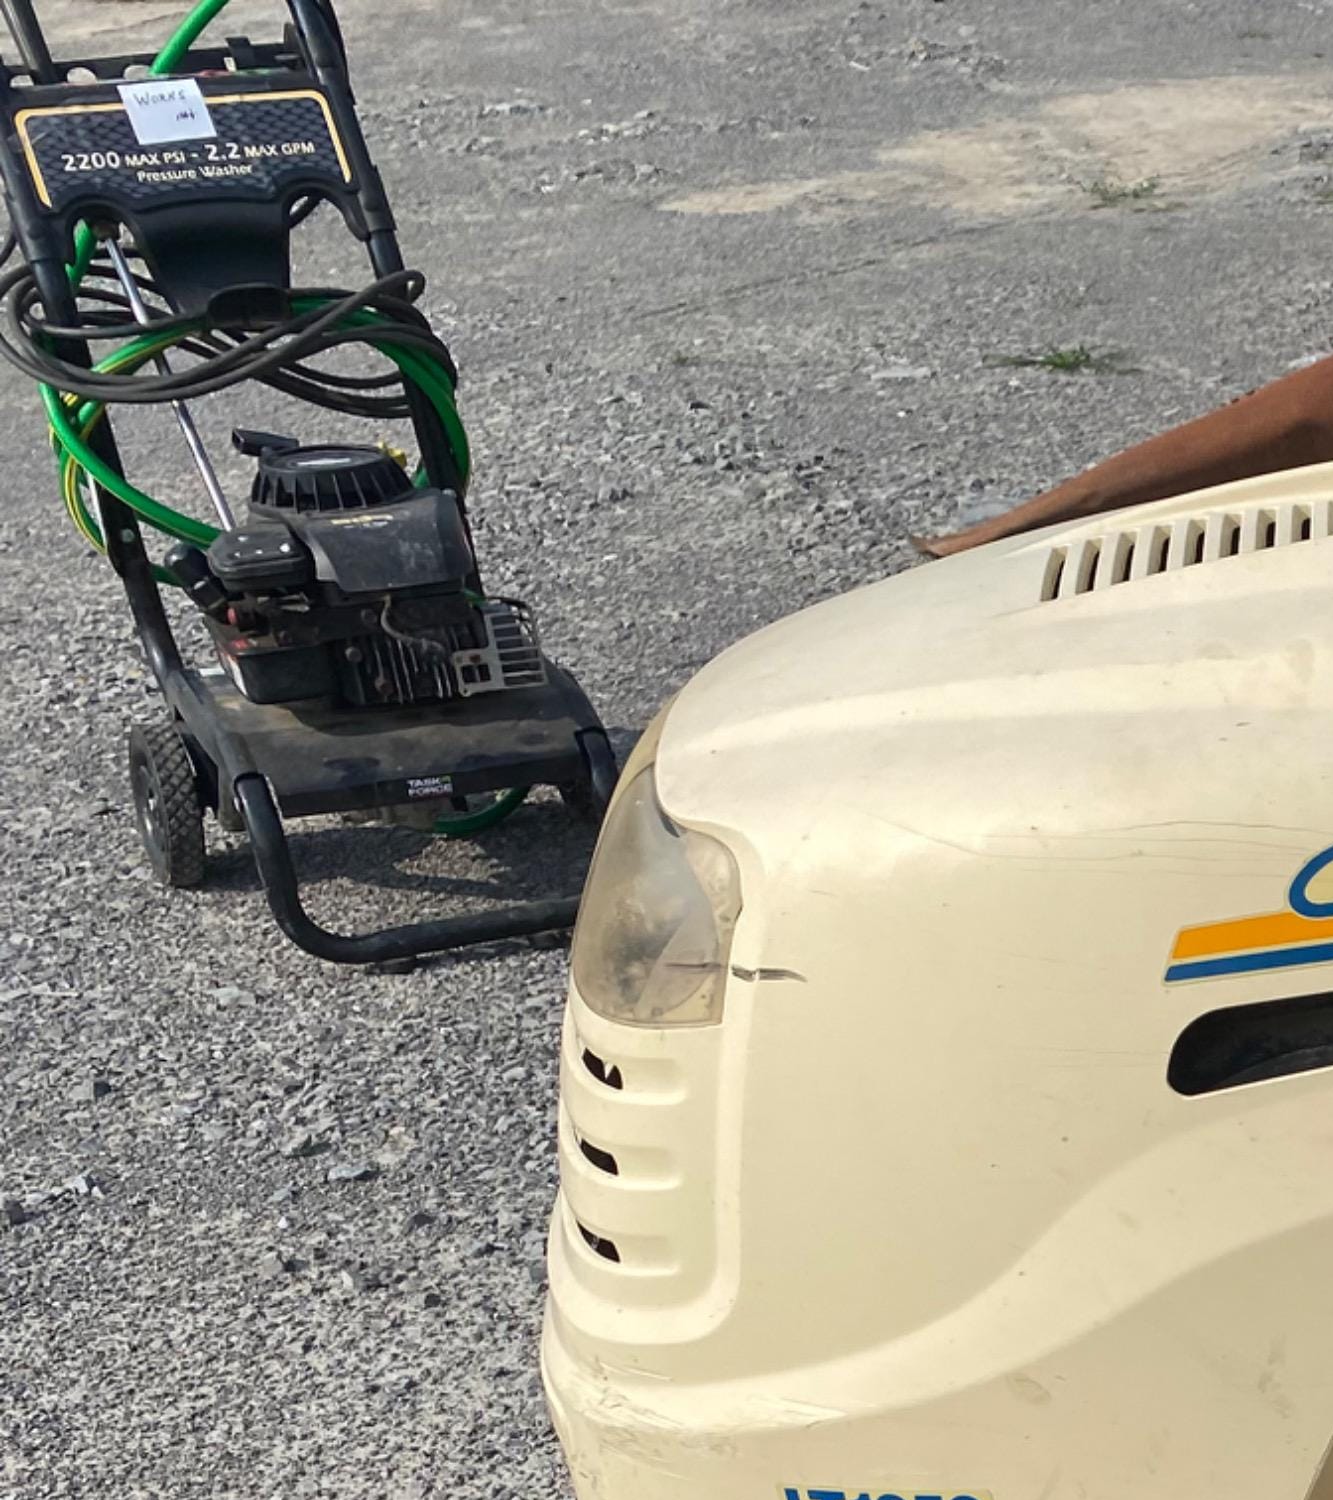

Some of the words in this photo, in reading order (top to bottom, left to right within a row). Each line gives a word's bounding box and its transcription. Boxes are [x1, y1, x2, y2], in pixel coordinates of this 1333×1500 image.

[61, 151, 120, 172] 2200
[124, 152, 159, 168] MAX
[163, 150, 186, 165] PSI
[204, 142, 241, 162] 2.2
[244, 144, 278, 158] MAX
[281, 141, 316, 155] GPM
[136, 167, 197, 183] Pressure
[199, 164, 253, 179] Washer
